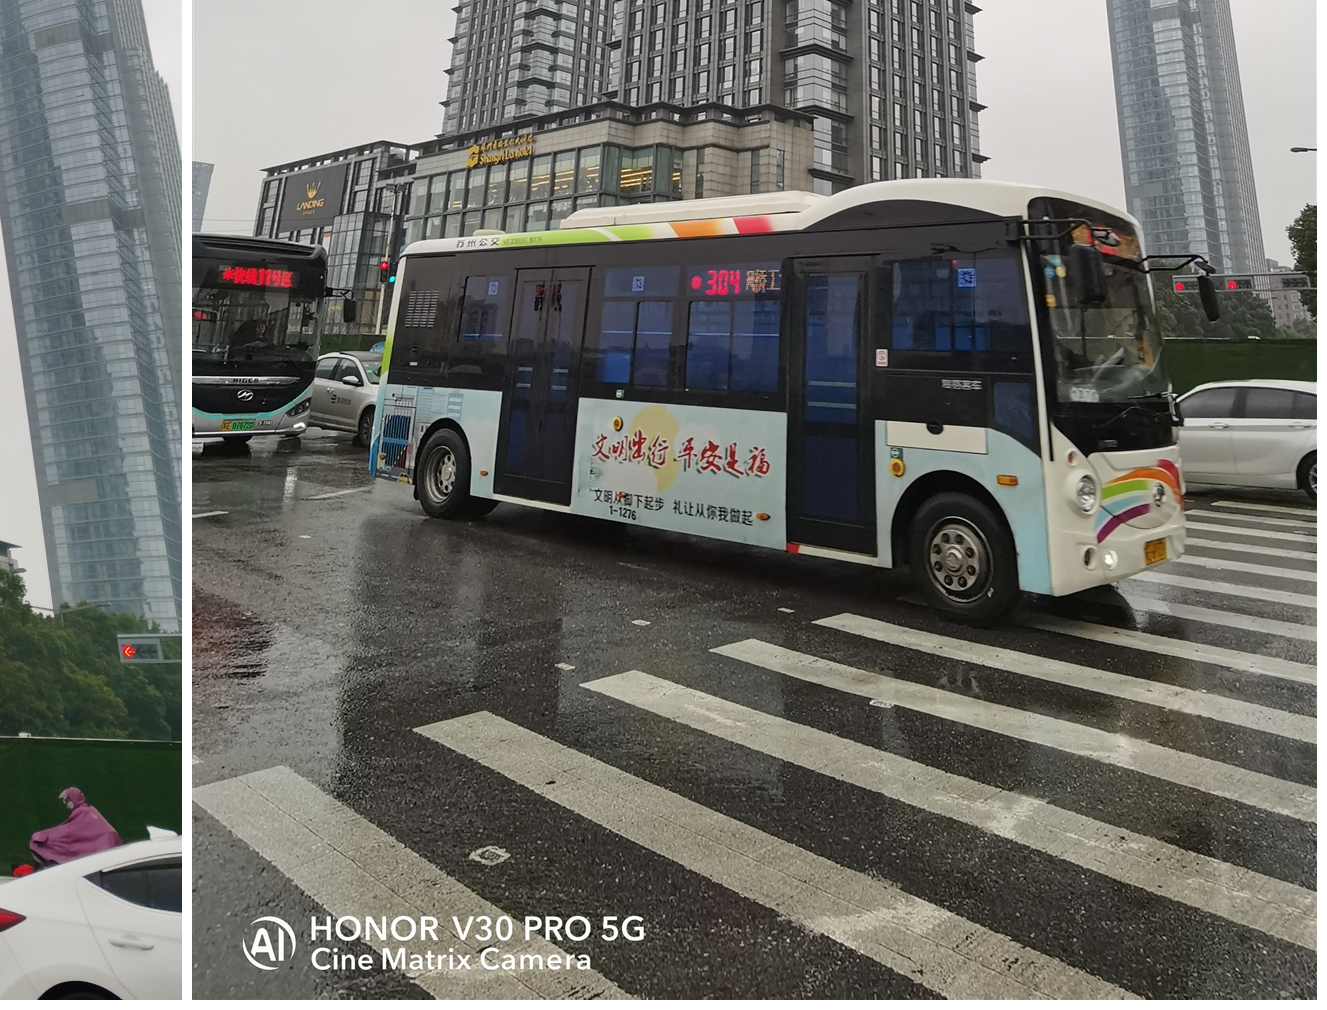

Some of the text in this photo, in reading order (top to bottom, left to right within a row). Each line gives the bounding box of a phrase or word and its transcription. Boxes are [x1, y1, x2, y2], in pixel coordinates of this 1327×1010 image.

[705, 270, 740, 296] 304
[591, 429, 771, 476] 文明出行 平安是福
[609, 505, 637, 521] 1-1276
[672, 499, 754, 526] 礼让从你我做起
